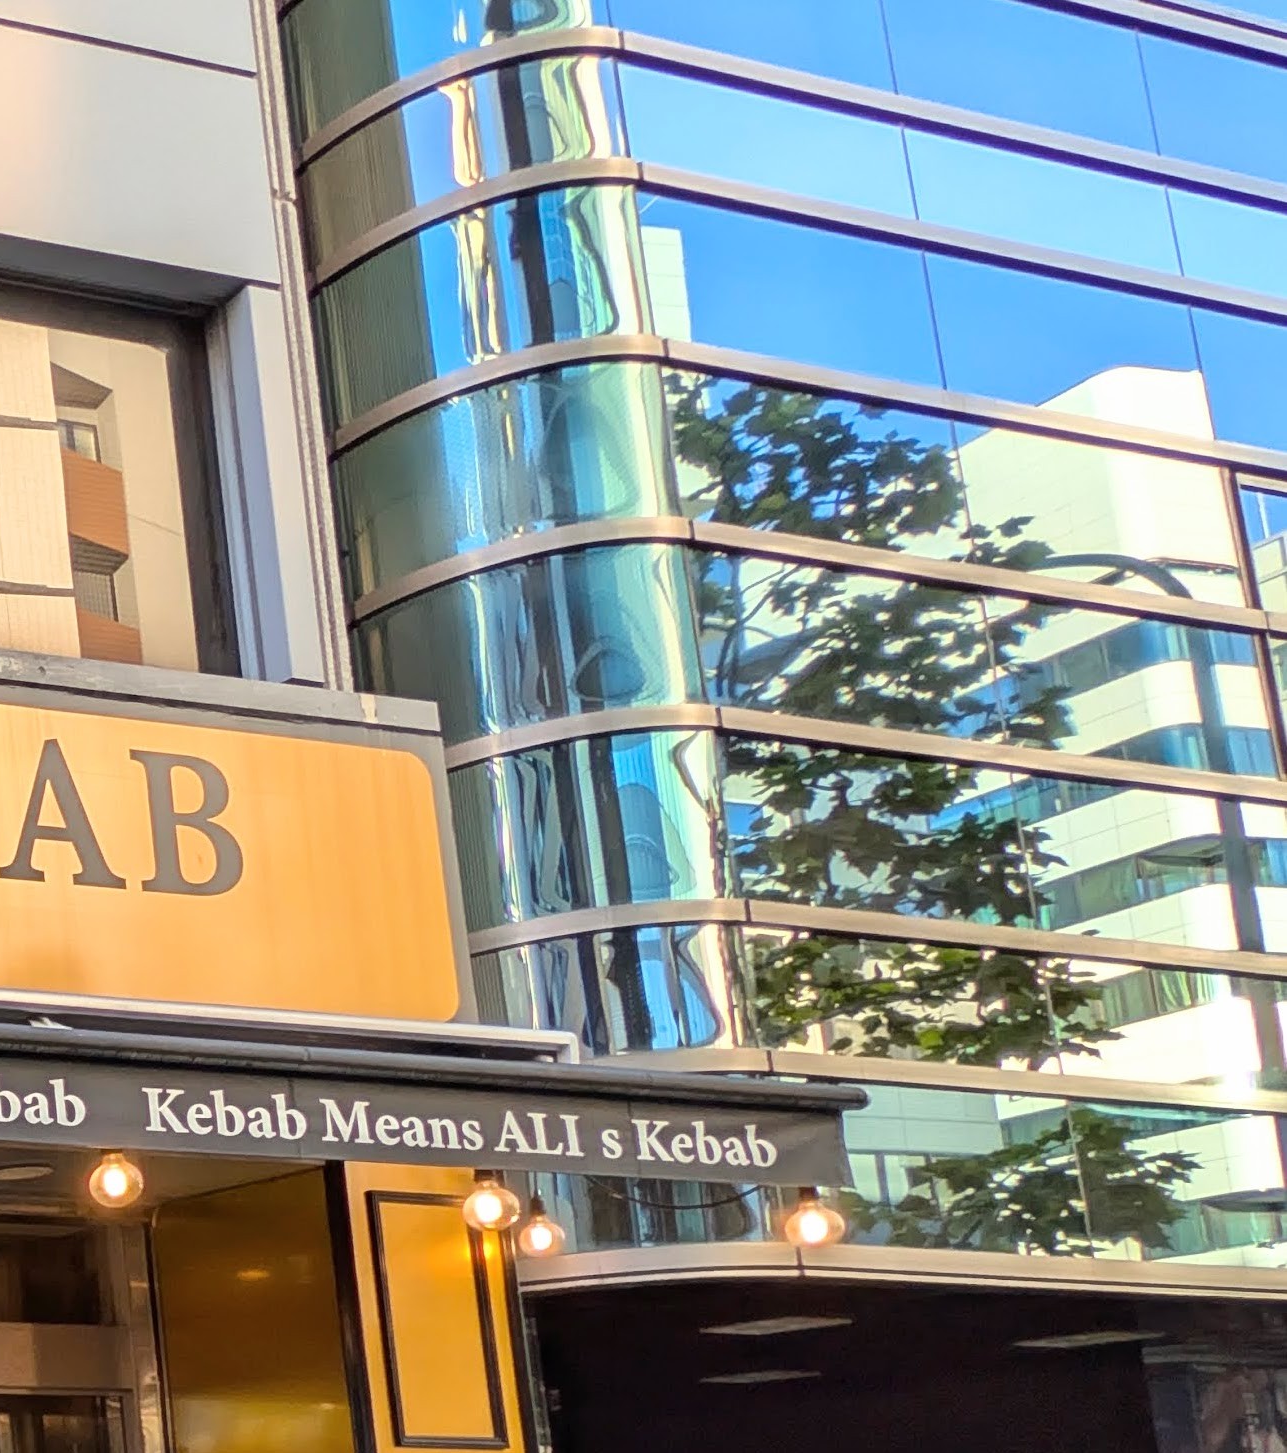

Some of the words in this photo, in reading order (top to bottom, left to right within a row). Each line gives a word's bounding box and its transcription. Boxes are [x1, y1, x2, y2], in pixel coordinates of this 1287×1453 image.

[142, 1087, 308, 1141] Kebab
[319, 1098, 485, 1152] Means
[493, 1110, 585, 1157] ALI
[601, 1126, 623, 1159] s
[631, 1119, 778, 1168] Kebab
